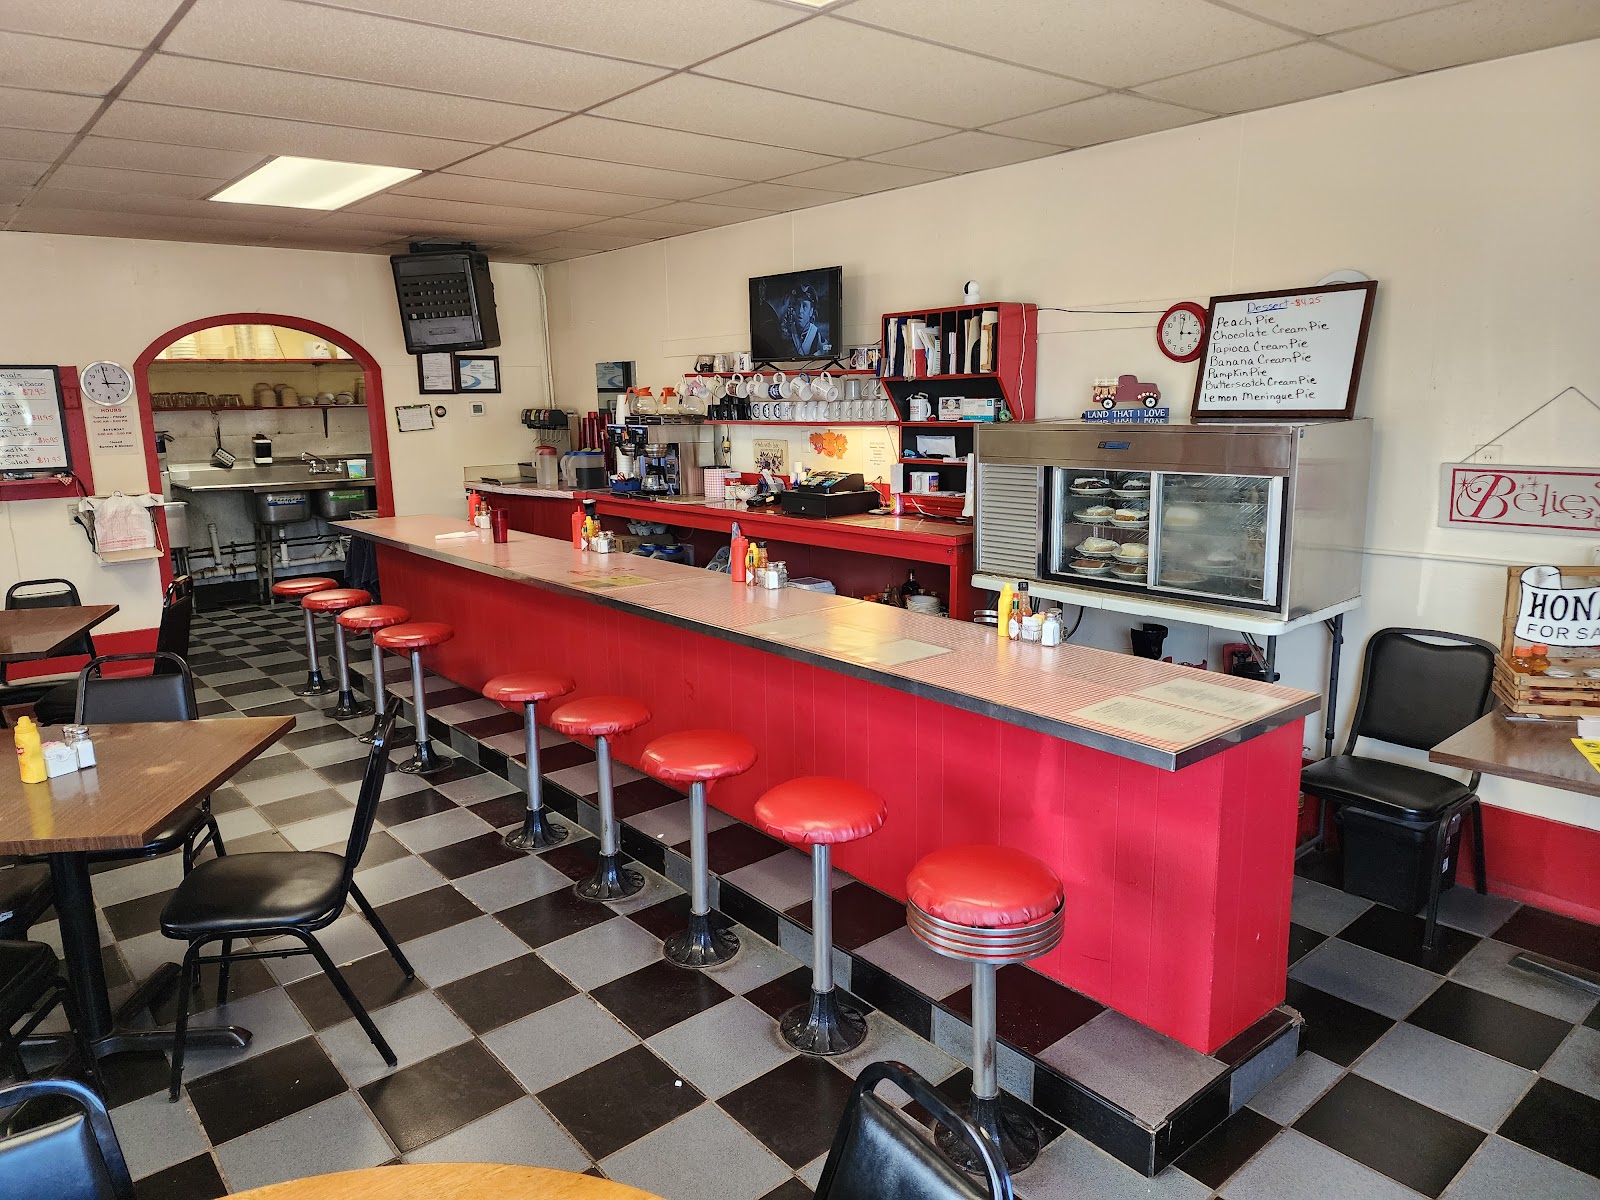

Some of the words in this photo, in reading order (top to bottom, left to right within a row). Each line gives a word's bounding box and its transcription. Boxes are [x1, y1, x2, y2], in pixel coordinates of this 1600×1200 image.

[1247, 299, 1289, 313] Dessert
[1216, 316, 1252, 329] Peach
[1255, 314, 1276, 325] Pie
[1212, 327, 1270, 341] Chocolate
[1271, 324, 1308, 334] Cream
[1308, 320, 1329, 331] Pie
[1210, 342, 1251, 355] Tapioca
[1253, 340, 1289, 352] Cream
[1289, 338, 1308, 349] Pie
[1210, 355, 1254, 367] Banana
[1257, 353, 1292, 365] Cream
[1292, 351, 1312, 363] Pie
[1250, 366, 1268, 377] Pie
[1205, 378, 1265, 391] Butterscotch
[1267, 376, 1298, 387] Cream
[1298, 374, 1317, 385] Pie
[1204, 392, 1238, 403] Lemon
[1242, 391, 1294, 404] Meringue
[1295, 388, 1316, 399] Pie
[1087, 410, 1109, 418] LAND
[1112, 409, 1135, 418] THAT
[1137, 409, 1140, 417] I
[1144, 408, 1166, 417] LOVE
[1527, 591, 1600, 621] HON
[1527, 623, 1570, 639] FOR
